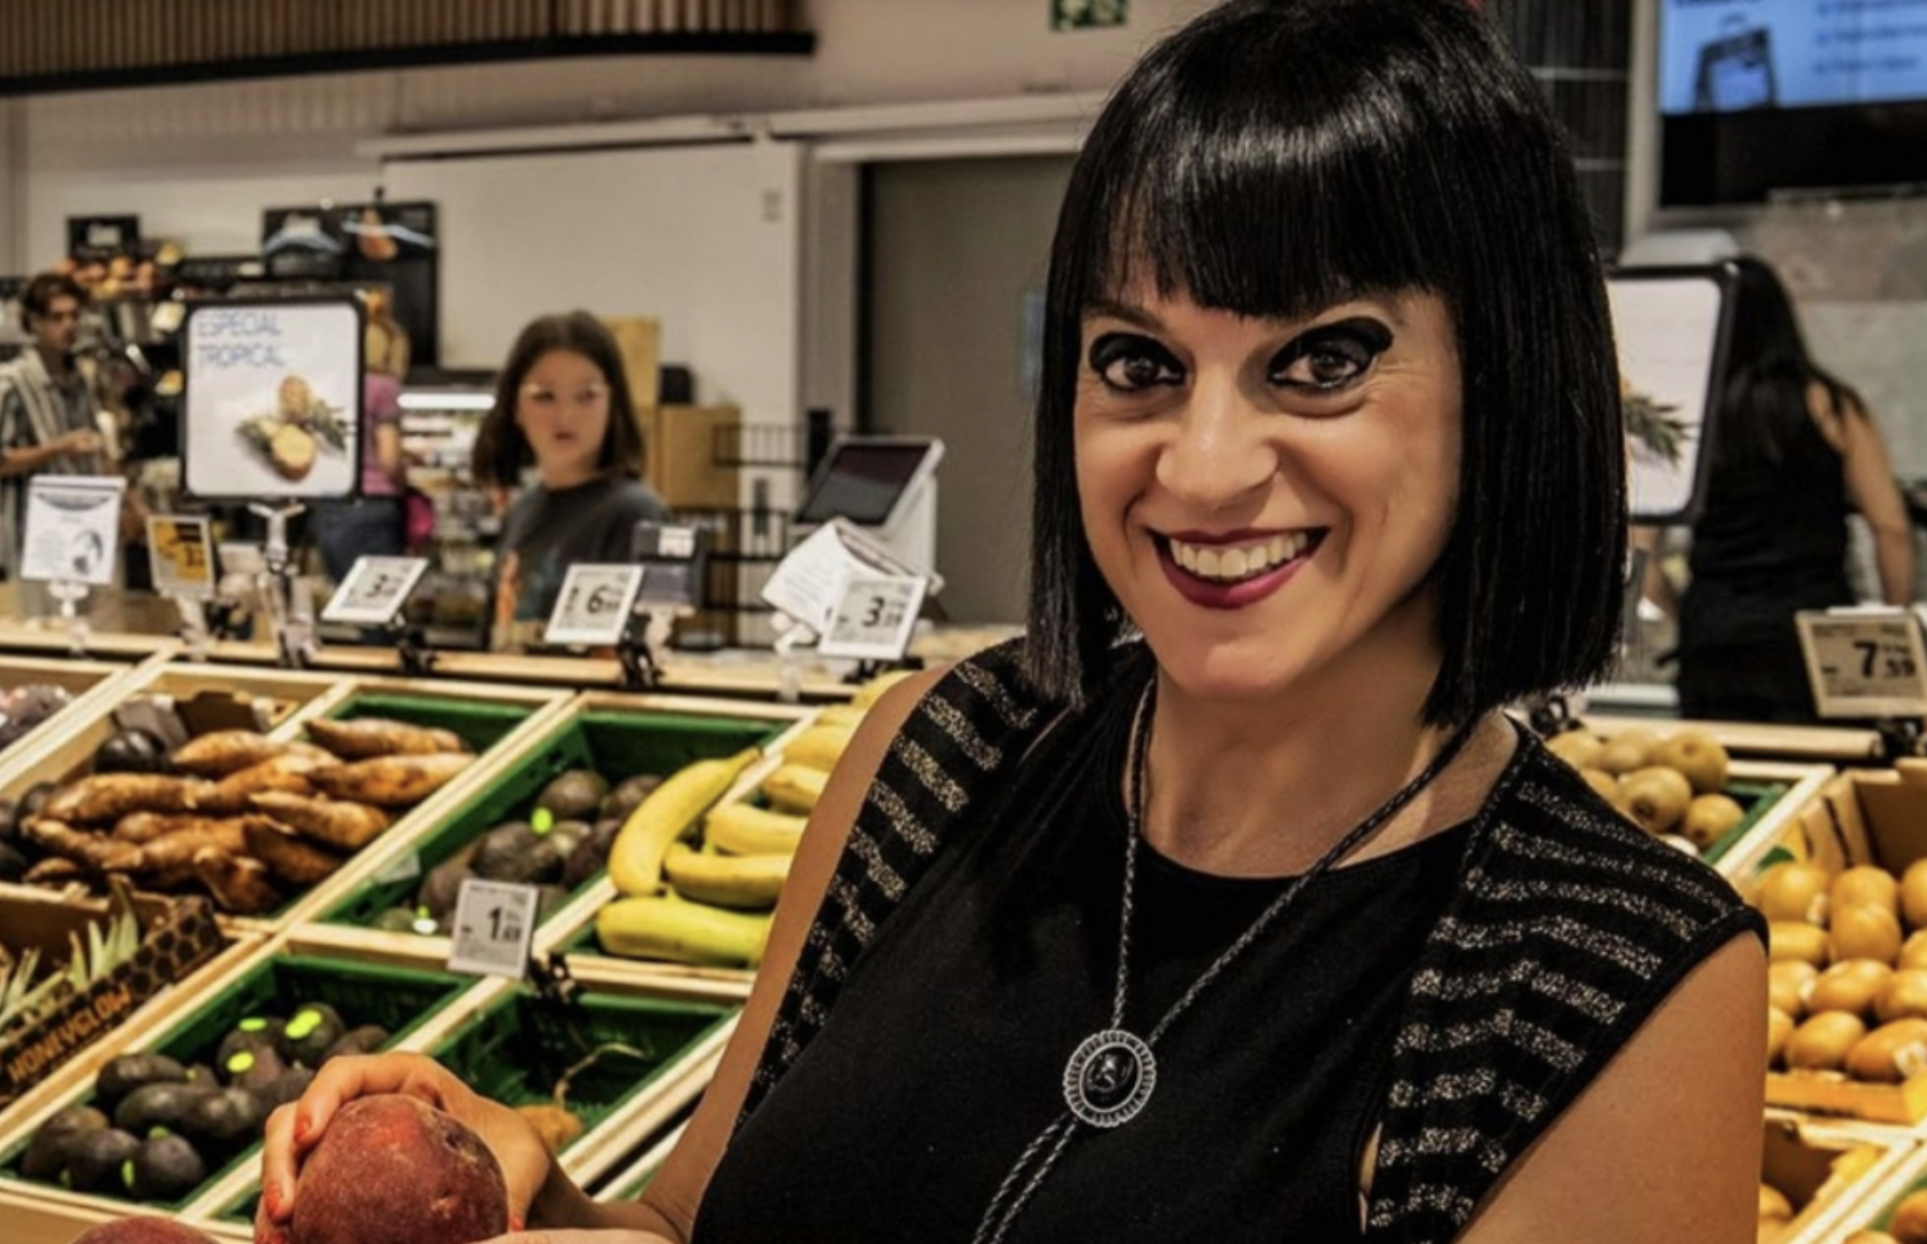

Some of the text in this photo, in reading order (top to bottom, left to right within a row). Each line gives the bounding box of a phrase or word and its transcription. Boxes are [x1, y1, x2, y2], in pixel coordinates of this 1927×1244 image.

[198, 309, 282, 337] ESPECIAL
[198, 342, 286, 368] TROPICAL
[586, 585, 610, 614] 6
[861, 596, 885, 628] 3
[1852, 641, 1878, 679] 7
[488, 905, 502, 941] 1
